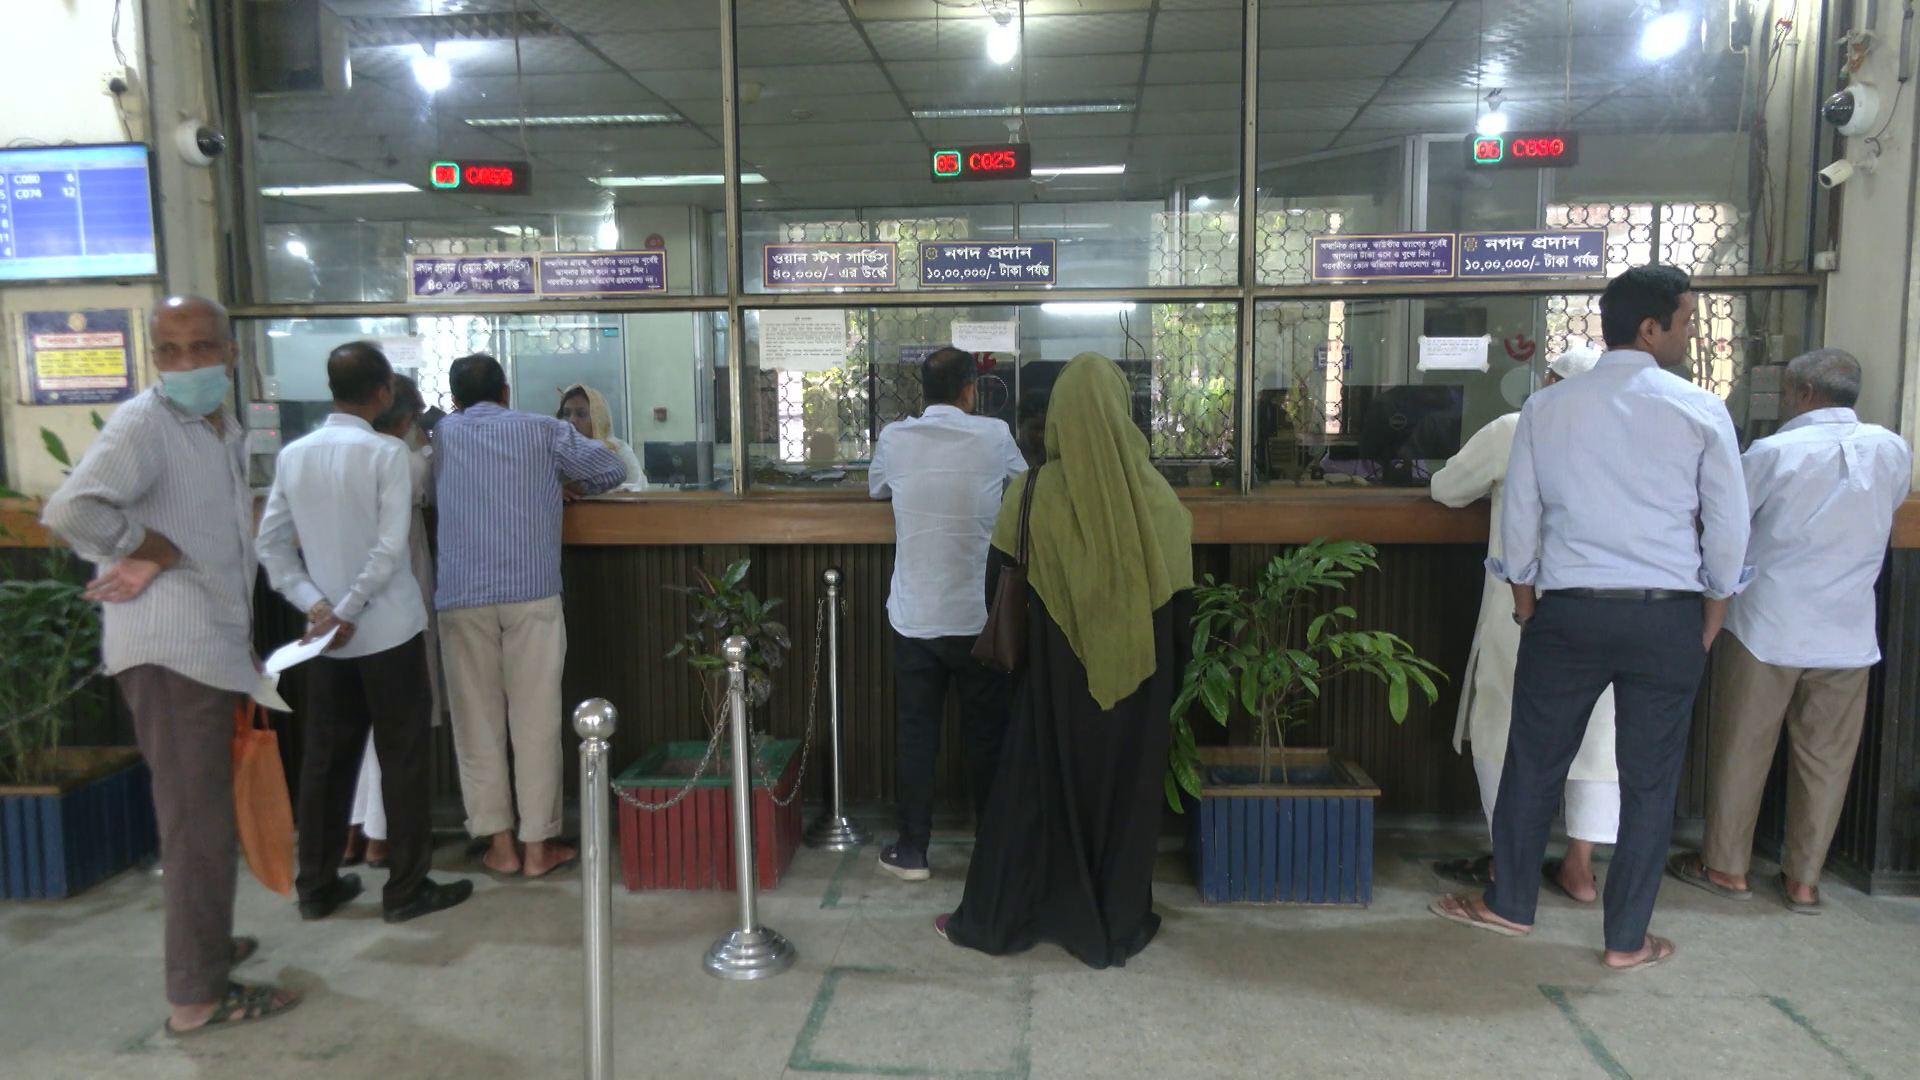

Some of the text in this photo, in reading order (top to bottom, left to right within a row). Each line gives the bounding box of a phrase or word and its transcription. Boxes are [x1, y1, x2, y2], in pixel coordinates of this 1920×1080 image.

[969, 151, 1015, 170] C025
[15, 187, 75, 200] C074 12
[1483, 235, 1581, 251] নগদ প্রদান
[943, 245, 1033, 260] নগদ প্রদান
[1543, 252, 1569, 268] টাকা
[926, 263, 997, 281] ১০,০০,০০০/-
[998, 261, 1022, 277] টাকা
[1318, 350, 1349, 366] ET
